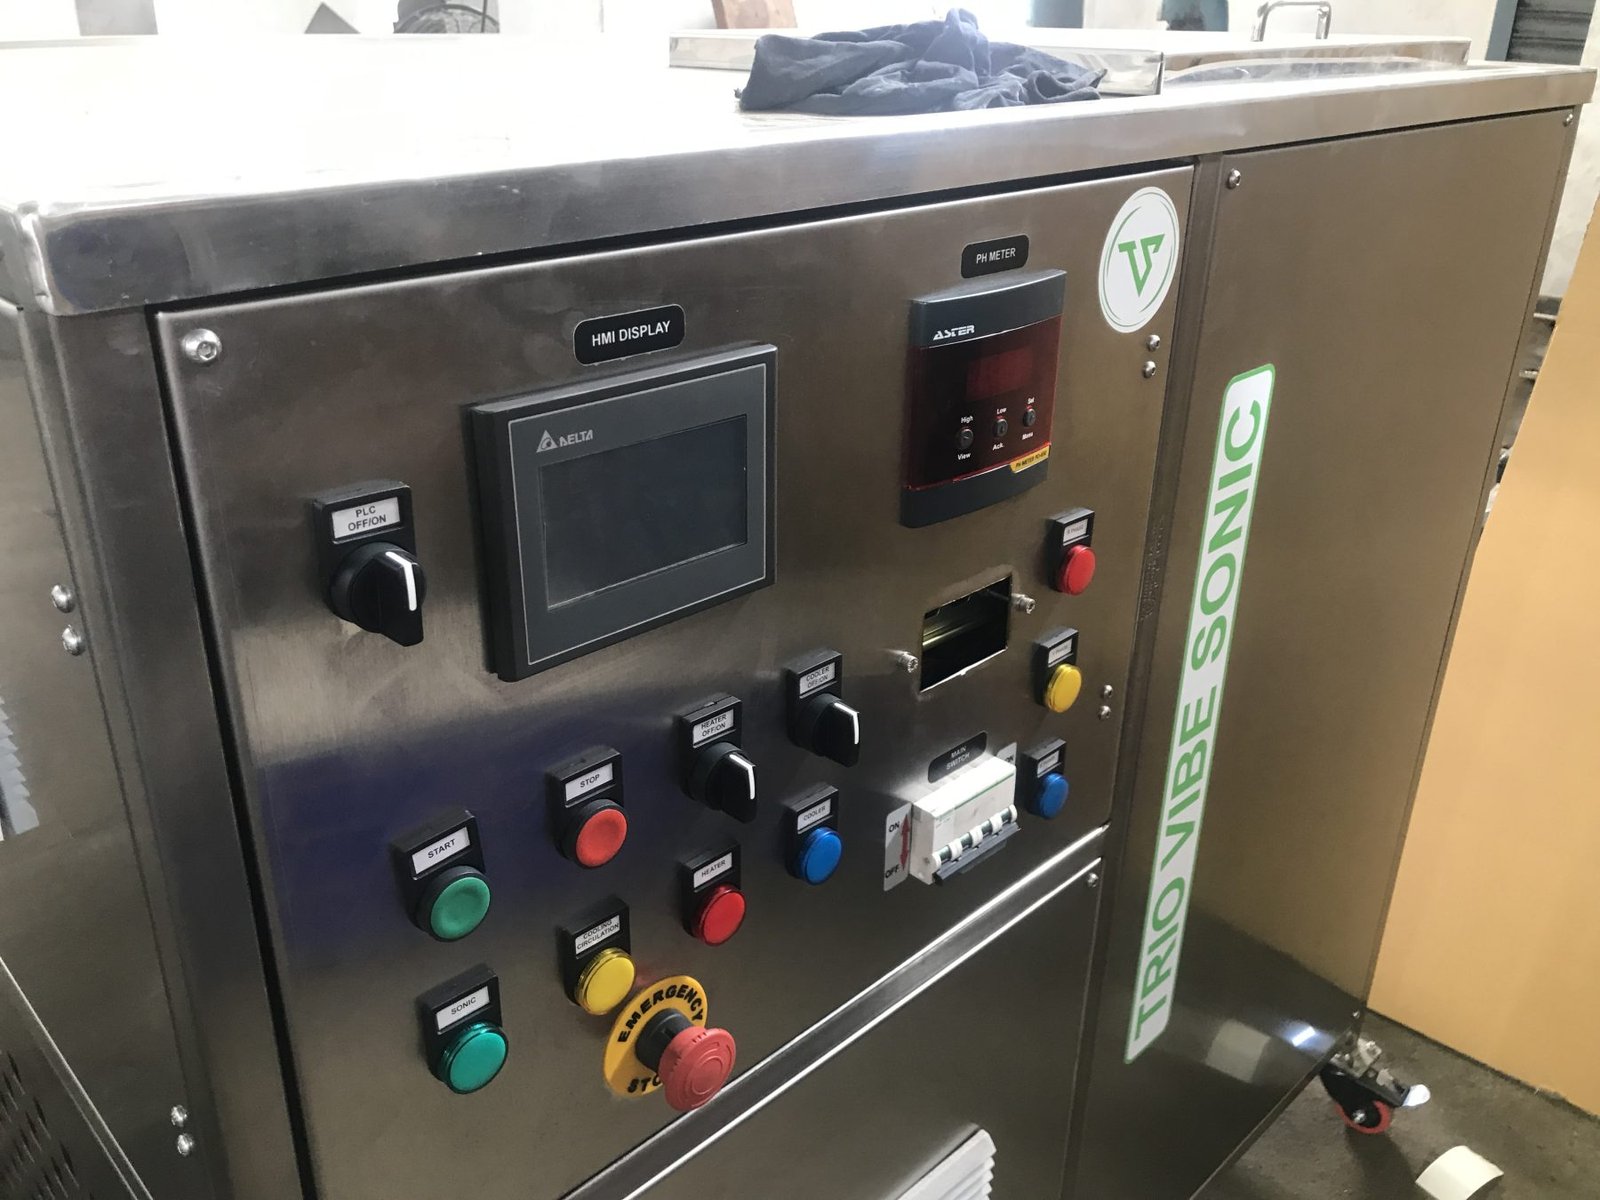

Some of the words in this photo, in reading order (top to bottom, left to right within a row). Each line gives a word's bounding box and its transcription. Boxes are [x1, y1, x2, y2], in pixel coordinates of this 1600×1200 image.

[976, 253, 988, 264] PH
[989, 247, 1016, 262] METER
[592, 331, 616, 347] HMI
[619, 320, 671, 342] DISPLAY
[933, 325, 975, 341] ASTER
[960, 415, 974, 424] High
[559, 429, 594, 448] DELTA
[957, 453, 972, 461] View
[355, 505, 376, 518] PLC
[347, 514, 387, 531] OFF/ON
[701, 714, 727, 730] HEATER
[1134, 877, 1186, 1039] TRIO
[1160, 685, 1217, 871] VIBE
[1191, 400, 1261, 671] SONIC
[702, 723, 726, 737] OFF/ON
[951, 746, 967, 758] MAIN
[946, 752, 970, 770] SWITCH
[580, 774, 600, 788] STOP
[803, 805, 826, 821] COOLER
[888, 821, 900, 832] ON
[427, 838, 455, 859] START
[701, 859, 726, 877] HEATER
[885, 864, 900, 878] OFF
[576, 923, 620, 950] CIRCULATION
[583, 920, 612, 939] COOLING
[451, 996, 476, 1015] SONIC
[617, 984, 703, 1042] EMERGENCY
[627, 1072, 661, 1093] STO
